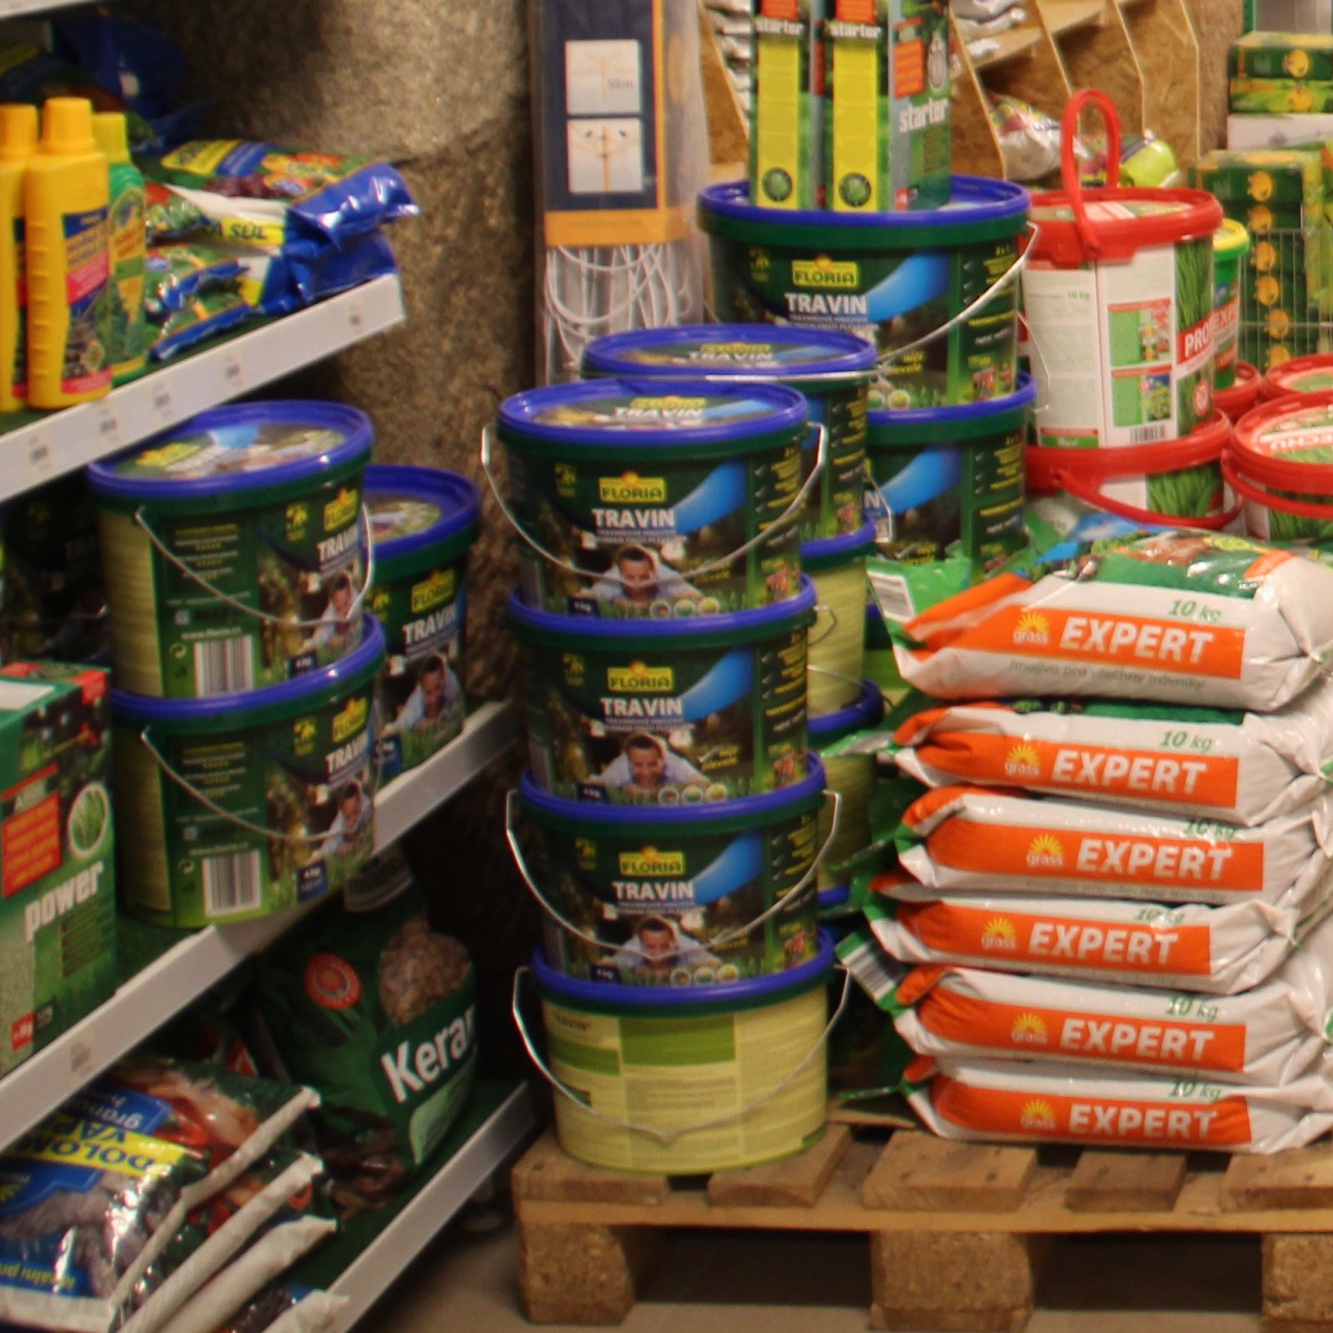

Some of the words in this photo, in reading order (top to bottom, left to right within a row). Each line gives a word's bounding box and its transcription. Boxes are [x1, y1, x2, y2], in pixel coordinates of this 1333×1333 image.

[755, 19, 803, 36] starter
[831, 22, 882, 38] starter
[899, 97, 949, 133] starter
[793, 269, 856, 284] FLORIA
[784, 292, 867, 314] TRAVIN
[599, 487, 665, 500] FLORIA
[591, 508, 676, 528] TRAVIN
[1167, 599, 1196, 618] 10
[1198, 606, 1222, 624] kg
[1012, 630, 1050, 646] grass
[1059, 615, 1214, 665] EXPERT
[608, 675, 672, 689] FLORIA
[600, 696, 683, 717] TRAVIN
[1159, 731, 1185, 748] 10
[1190, 736, 1214, 753] kg
[1004, 761, 1040, 776] grass
[1051, 749, 1207, 795] EXPERT
[1213, 823, 1237, 841] kg
[619, 860, 684, 874] FLORIA
[1026, 851, 1063, 867] grass
[1076, 838, 1233, 881] EXPERT
[24, 860, 104, 942] power
[611, 881, 694, 900] TRAVIN
[1136, 907, 1158, 923] 10
[1161, 910, 1185, 926] kg
[981, 935, 1017, 951] grass
[1028, 921, 1179, 965] EXPERT
[1165, 997, 1194, 1017] 10
[1197, 1004, 1219, 1022] kg
[1011, 1029, 1048, 1045] grass
[1060, 1018, 1214, 1062] EXPERT
[1168, 1080, 1197, 1099] 10
[1199, 1085, 1223, 1103] kg
[1020, 1115, 1056, 1131] grass
[1069, 1103, 1218, 1143] EXPERT
